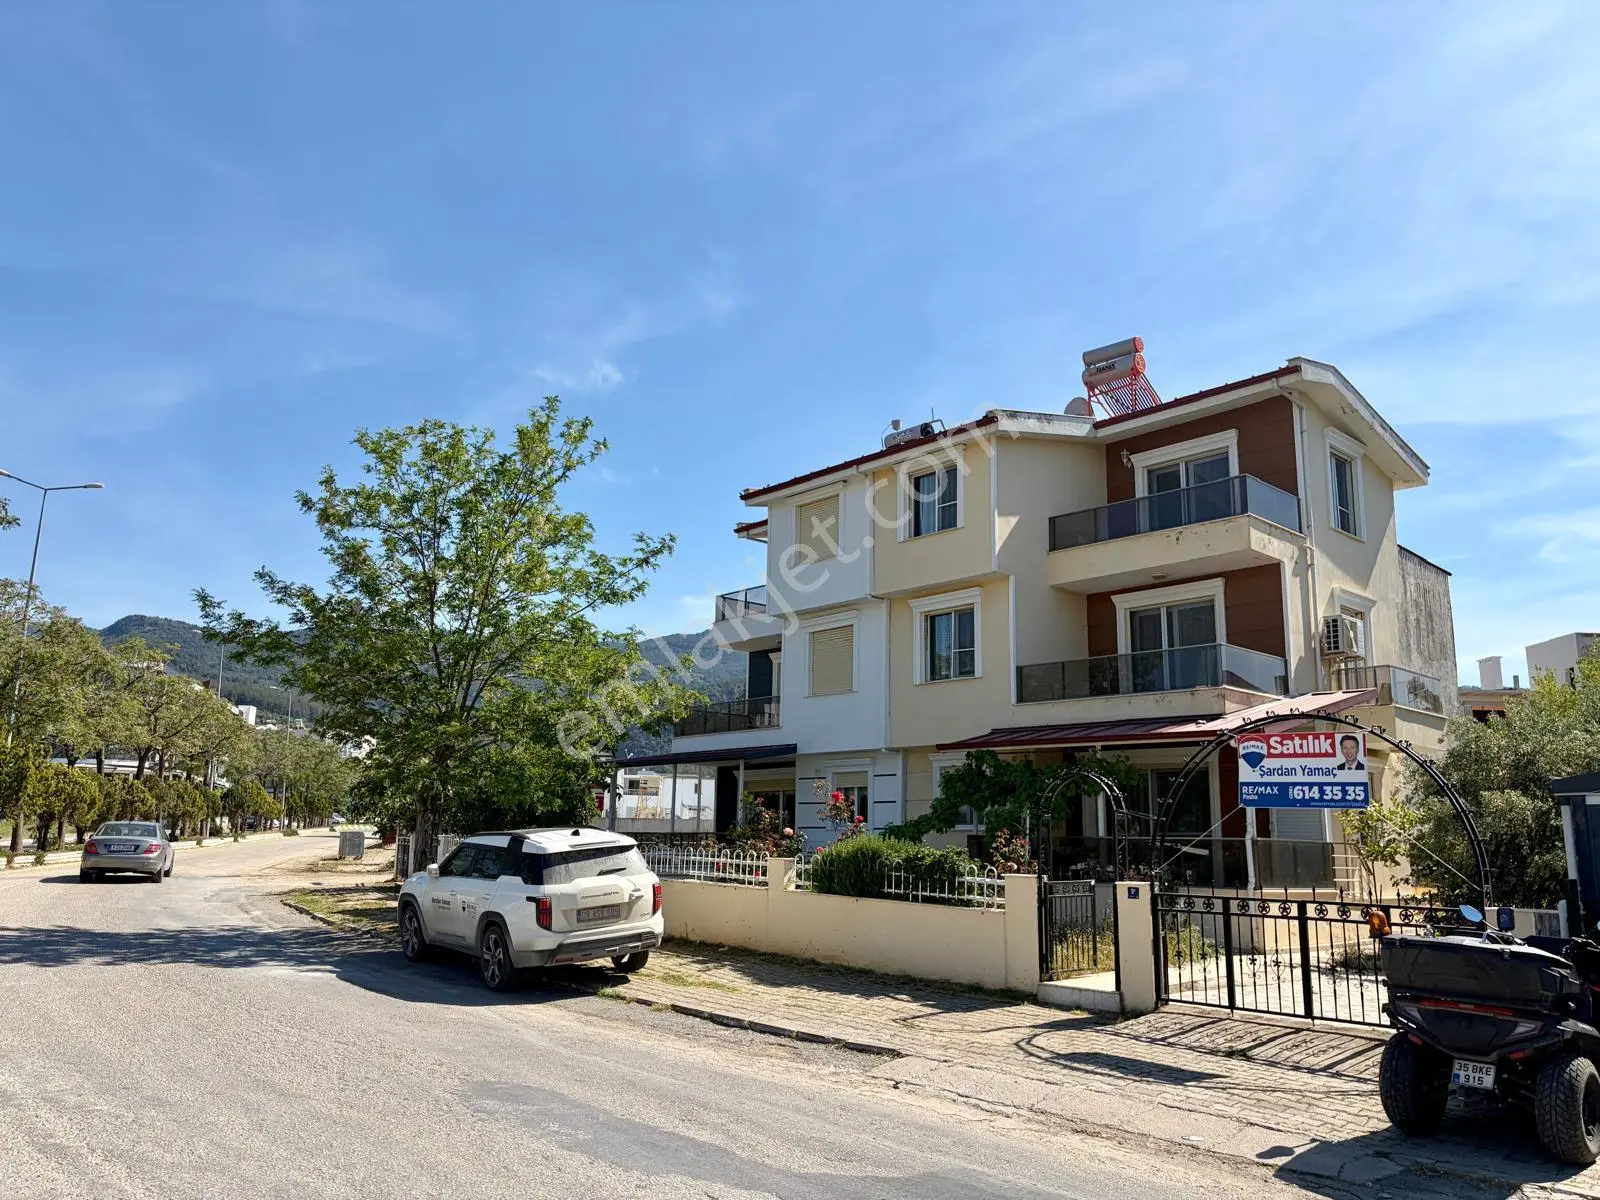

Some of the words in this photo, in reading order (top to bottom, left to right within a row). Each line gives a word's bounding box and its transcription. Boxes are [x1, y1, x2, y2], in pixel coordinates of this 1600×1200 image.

[1269, 735, 1333, 754] Satılık
[1259, 765, 1297, 778] Şardan
[1300, 765, 1337, 778] Yamaç
[1242, 785, 1279, 794] RE/MAX
[1293, 785, 1320, 800] 614
[1323, 785, 1342, 800] 35
[1345, 785, 1365, 800] 35
[1456, 1062, 1469, 1072] 35
[1471, 1065, 1492, 1076] BKE
[1463, 1074, 1484, 1085] 915
